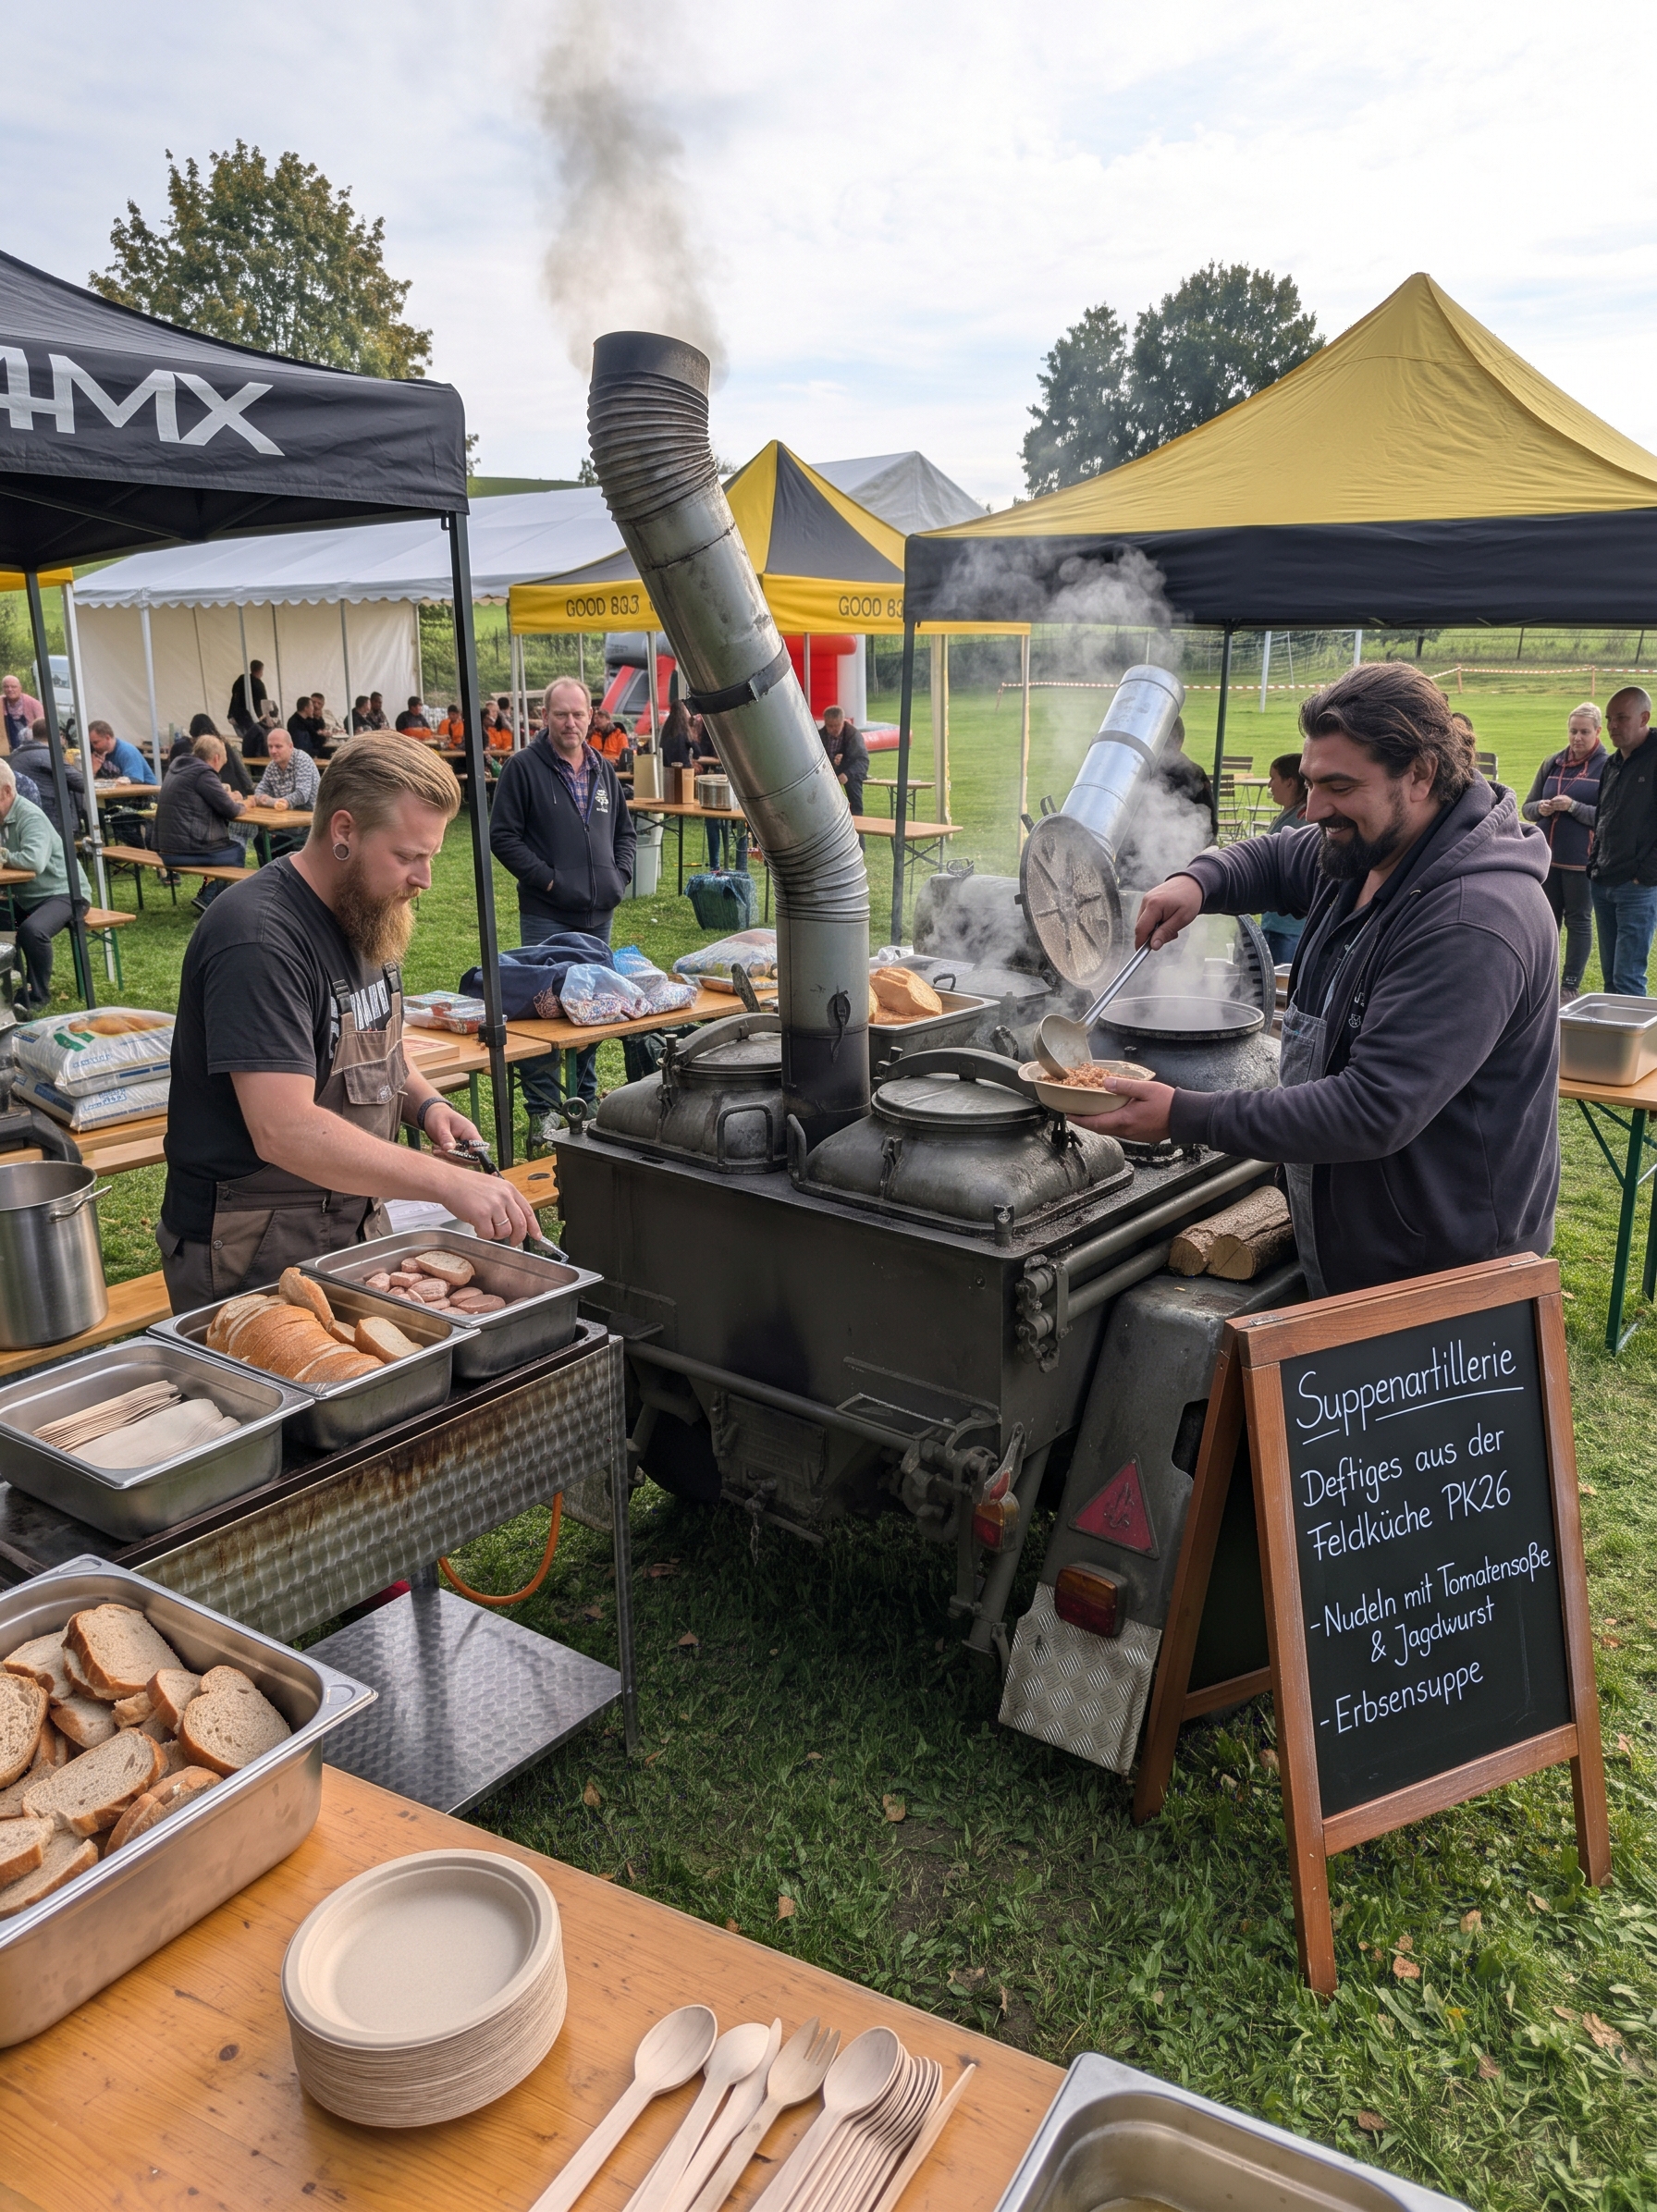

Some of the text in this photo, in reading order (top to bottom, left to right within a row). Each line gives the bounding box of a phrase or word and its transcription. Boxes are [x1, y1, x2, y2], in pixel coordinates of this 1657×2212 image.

[566, 596, 606, 617] GOOD
[839, 596, 881, 617] GOOD
[1295, 1339, 1516, 1436] Suppenartillerie
[1300, 1422, 1504, 1506] Deftiges aus der
[1307, 1469, 1511, 1561] Feldküche PK26
[1404, 1572, 1433, 1609] mit
[1436, 1542, 1552, 1597] Tomatensoße
[1370, 1594, 1495, 1666] & Jagdwurst
